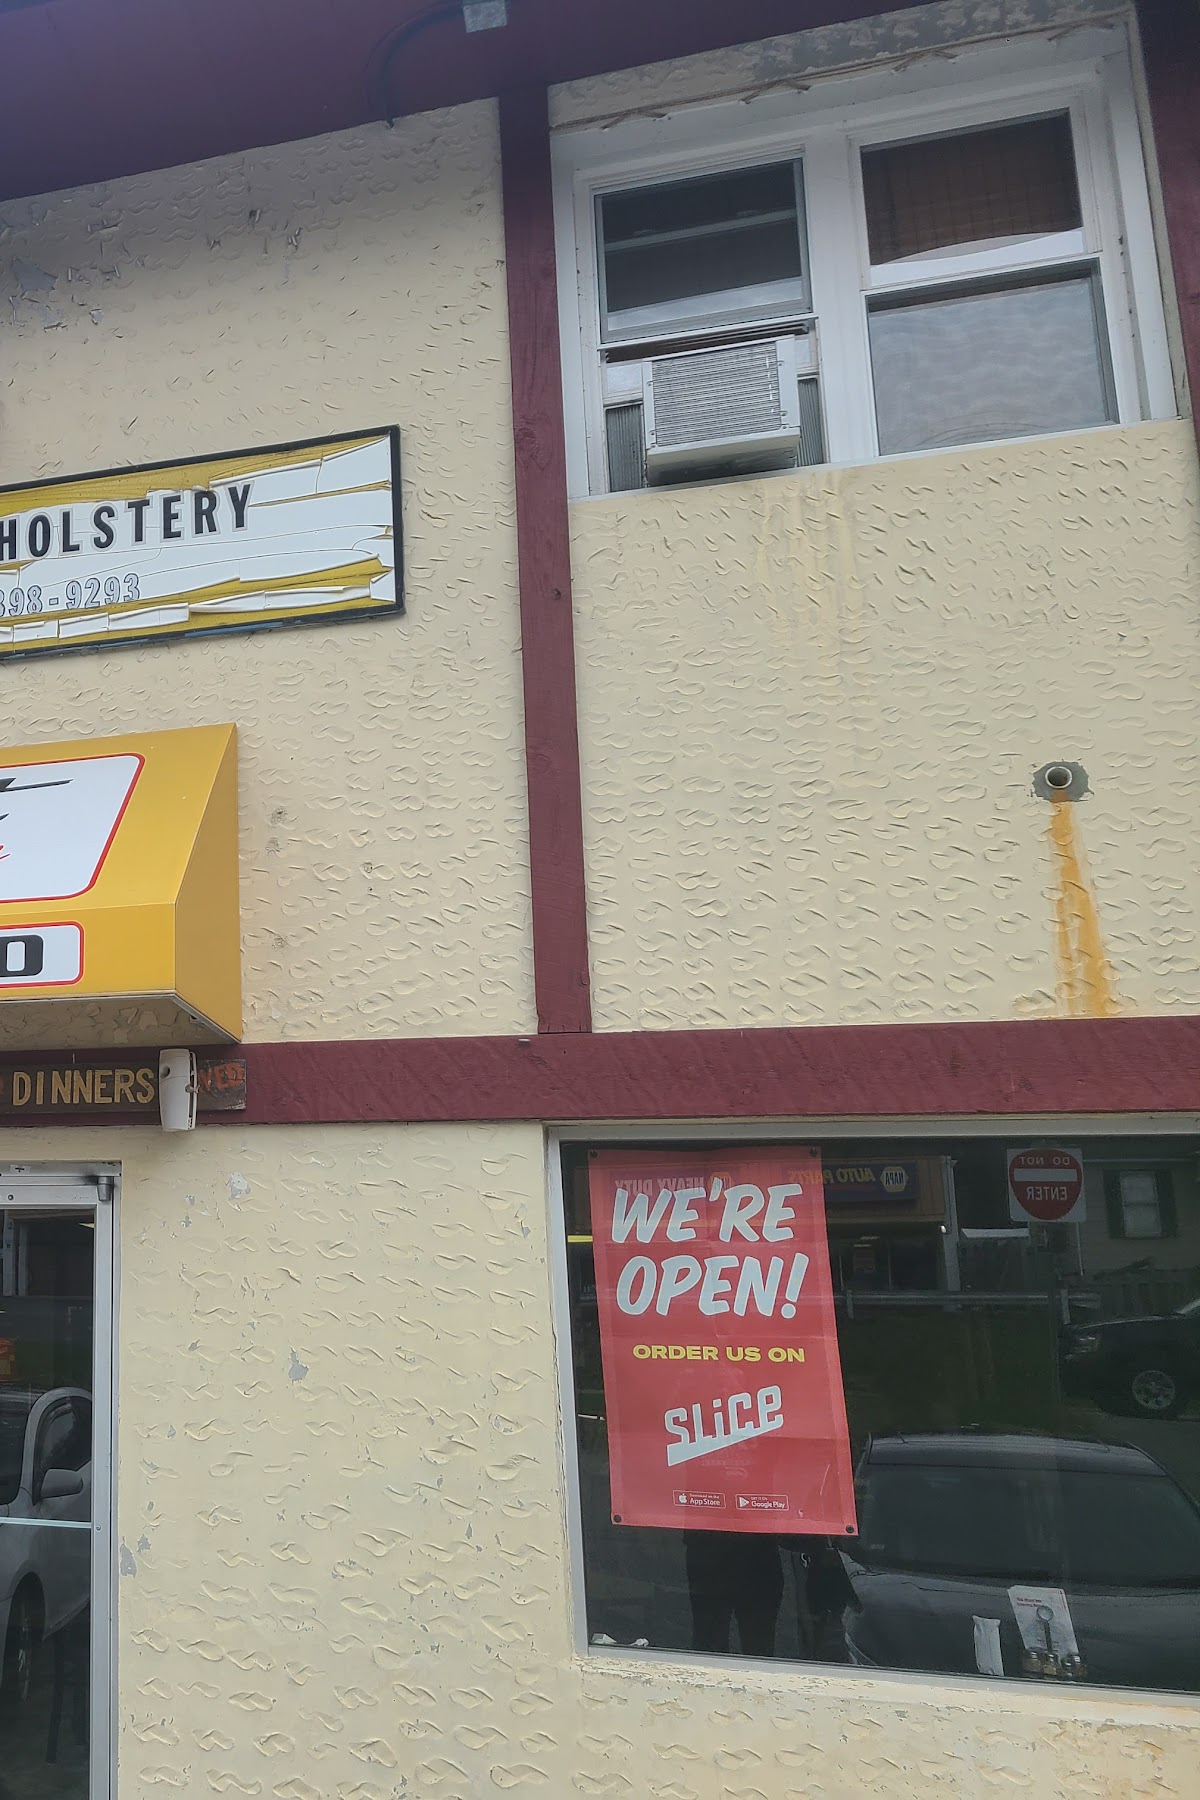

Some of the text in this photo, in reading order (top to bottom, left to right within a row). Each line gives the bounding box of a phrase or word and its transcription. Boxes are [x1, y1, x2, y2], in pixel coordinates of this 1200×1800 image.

[12, 1068, 155, 1106] DINNERS
[611, 1177, 803, 1244] WE'RE
[616, 1252, 809, 1320] OPEN!
[633, 1344, 805, 1363] ORDER US ON
[690, 1497, 721, 1506] App Store
[751, 1501, 773, 1509] Google
